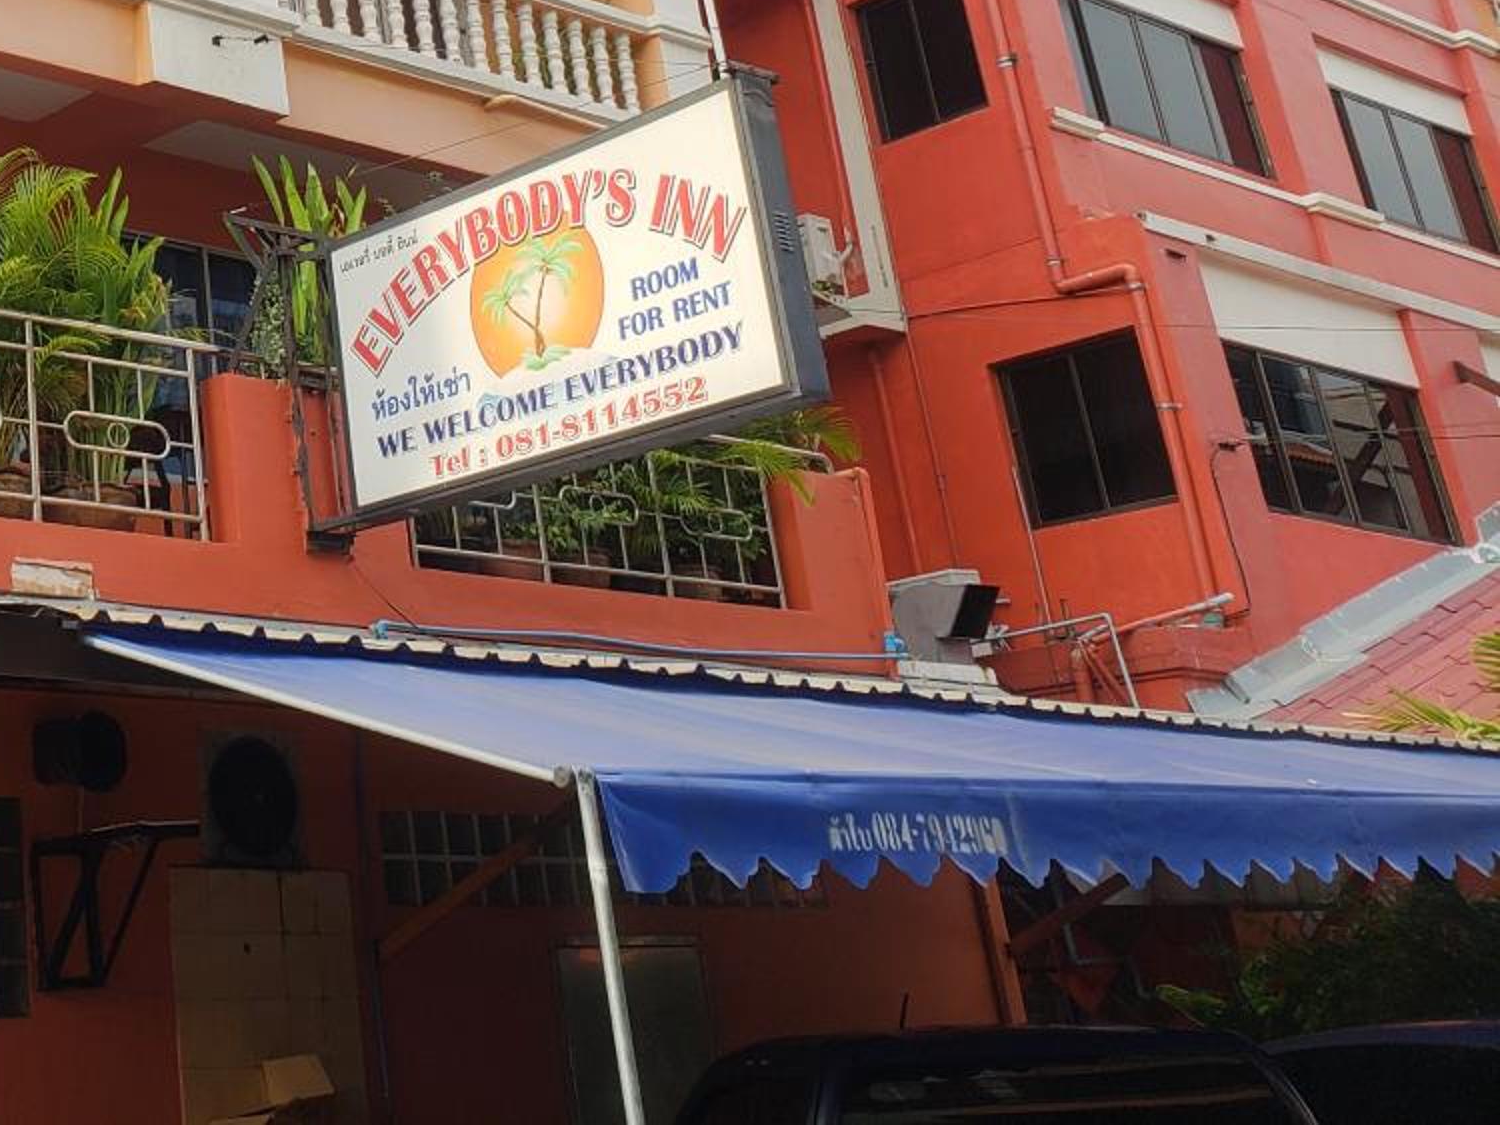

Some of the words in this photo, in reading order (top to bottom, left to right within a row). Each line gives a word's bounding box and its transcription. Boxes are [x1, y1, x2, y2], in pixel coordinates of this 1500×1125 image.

[349, 168, 636, 378] EVERYBODY'S
[648, 174, 747, 263] INN
[617, 306, 665, 341] FOR
[672, 280, 732, 323] RENT
[630, 257, 699, 301] ROOM
[371, 366, 472, 421] ห้องให้เช่า
[377, 426, 419, 459] WE
[423, 383, 558, 444] WELCOME
[563, 319, 744, 402] EVERYBODY
[429, 444, 472, 477] Tel
[495, 376, 708, 458] 081-8114552
